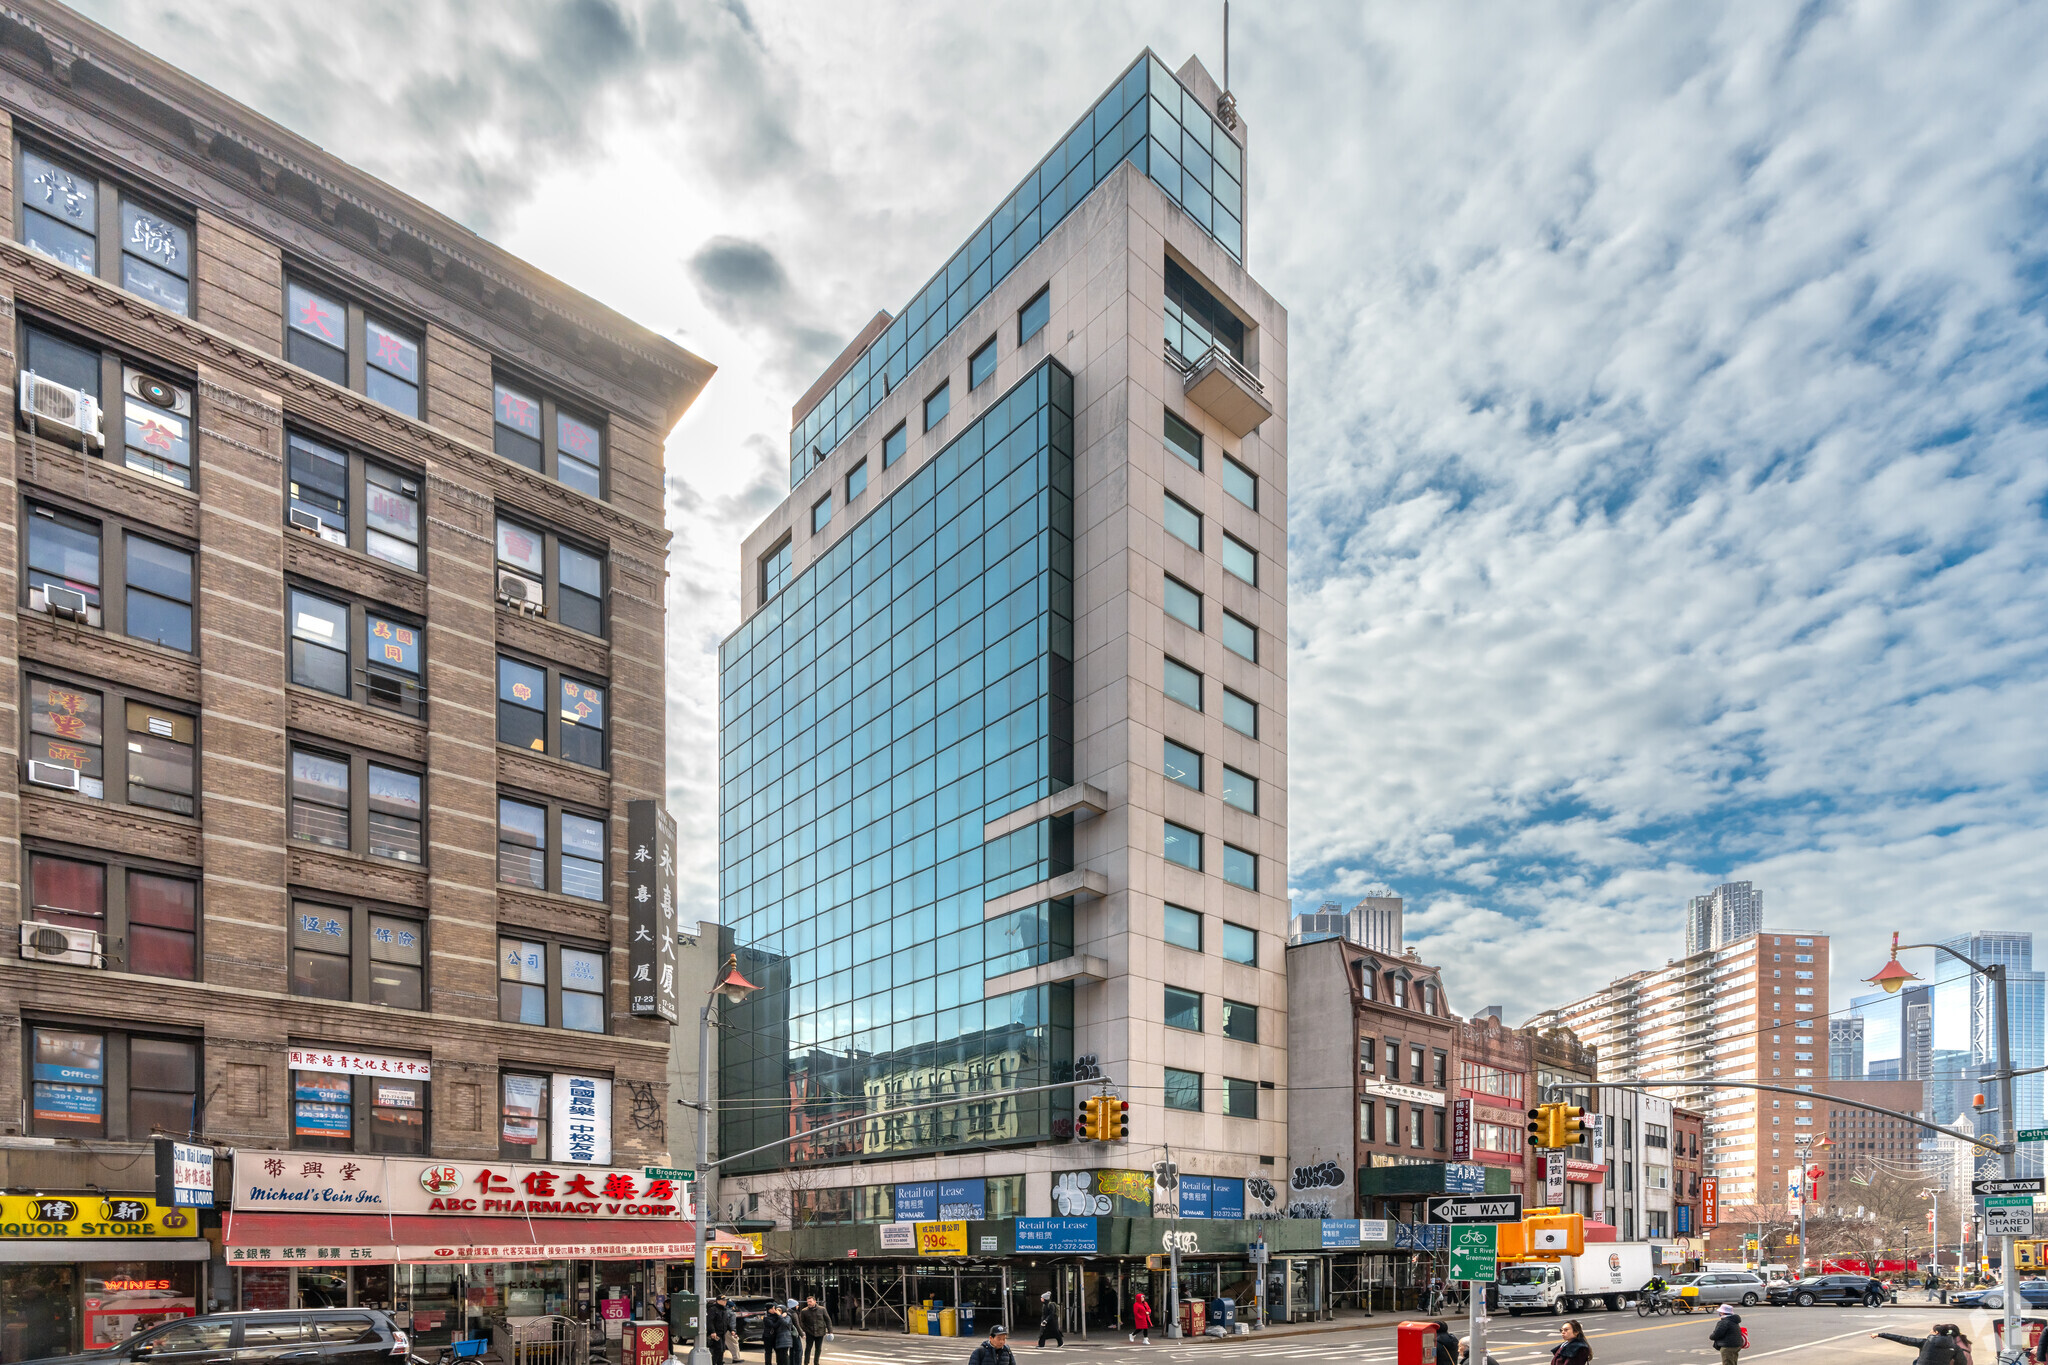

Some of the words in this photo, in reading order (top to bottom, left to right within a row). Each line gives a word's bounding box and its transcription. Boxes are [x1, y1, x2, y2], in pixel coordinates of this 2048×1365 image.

[300, 299, 334, 338] 大
[385, 643, 403, 663] 同
[374, 926, 416, 948] 保險
[507, 950, 539, 969] 公司
[61, 1069, 100, 1081] Office
[319, 1091, 349, 1100] Office
[569, 1078, 595, 1161] 美國長樂一中校友會
[174, 1146, 185, 1162] Sam
[197, 1150, 212, 1167] Liquor
[656, 1168, 693, 1178] Broadway
[473, 1168, 679, 1201] 仁信大藥房
[1182, 1181, 1201, 1190] Retail
[1201, 1182, 1211, 1191] for
[1213, 1183, 1230, 1192] Lease
[1982, 1183, 2002, 1191] ONE
[2012, 1182, 2035, 1190] WAY
[175, 1188, 189, 1203] WINE
[189, 1190, 194, 1203] &
[195, 1191, 213, 1205] LIQUOR
[250, 1186, 319, 1202] Micheal's
[321, 1187, 353, 1202] Coin
[355, 1190, 382, 1203] Inc.
[898, 1187, 921, 1199] Retail
[922, 1187, 935, 1198] for
[940, 1186, 965, 1197] Lease
[428, 1198, 477, 1211] ABC
[483, 1199, 603, 1214] PHARMACY
[607, 1203, 622, 1214] V
[625, 1203, 680, 1217] CORP.
[1441, 1205, 1467, 1216] ONE
[1480, 1203, 1509, 1215] WAY
[1705, 1184, 1714, 1222] DINER
[114, 1201, 142, 1221] 新
[897, 1211, 925, 1219] NEWMARK
[166, 1215, 183, 1226] 17
[1018, 1220, 1045, 1229] Retail
[1047, 1220, 1061, 1229] for
[1062, 1220, 1089, 1229] Lease
[1989, 1218, 2030, 1226] SHARED
[81, 1222, 155, 1235] STORE
[922, 1223, 960, 1233] 成功貿易公司
[923, 1233, 947, 1248] 99¢
[233, 1247, 271, 1259] 金銀幣
[283, 1247, 307, 1259] 紙幣
[317, 1247, 341, 1259] 郵票
[350, 1247, 372, 1259] 古玩
[104, 1279, 170, 1290] WINES
[606, 1309, 624, 1319] $50
[640, 1355, 665, 1365] LOVE
